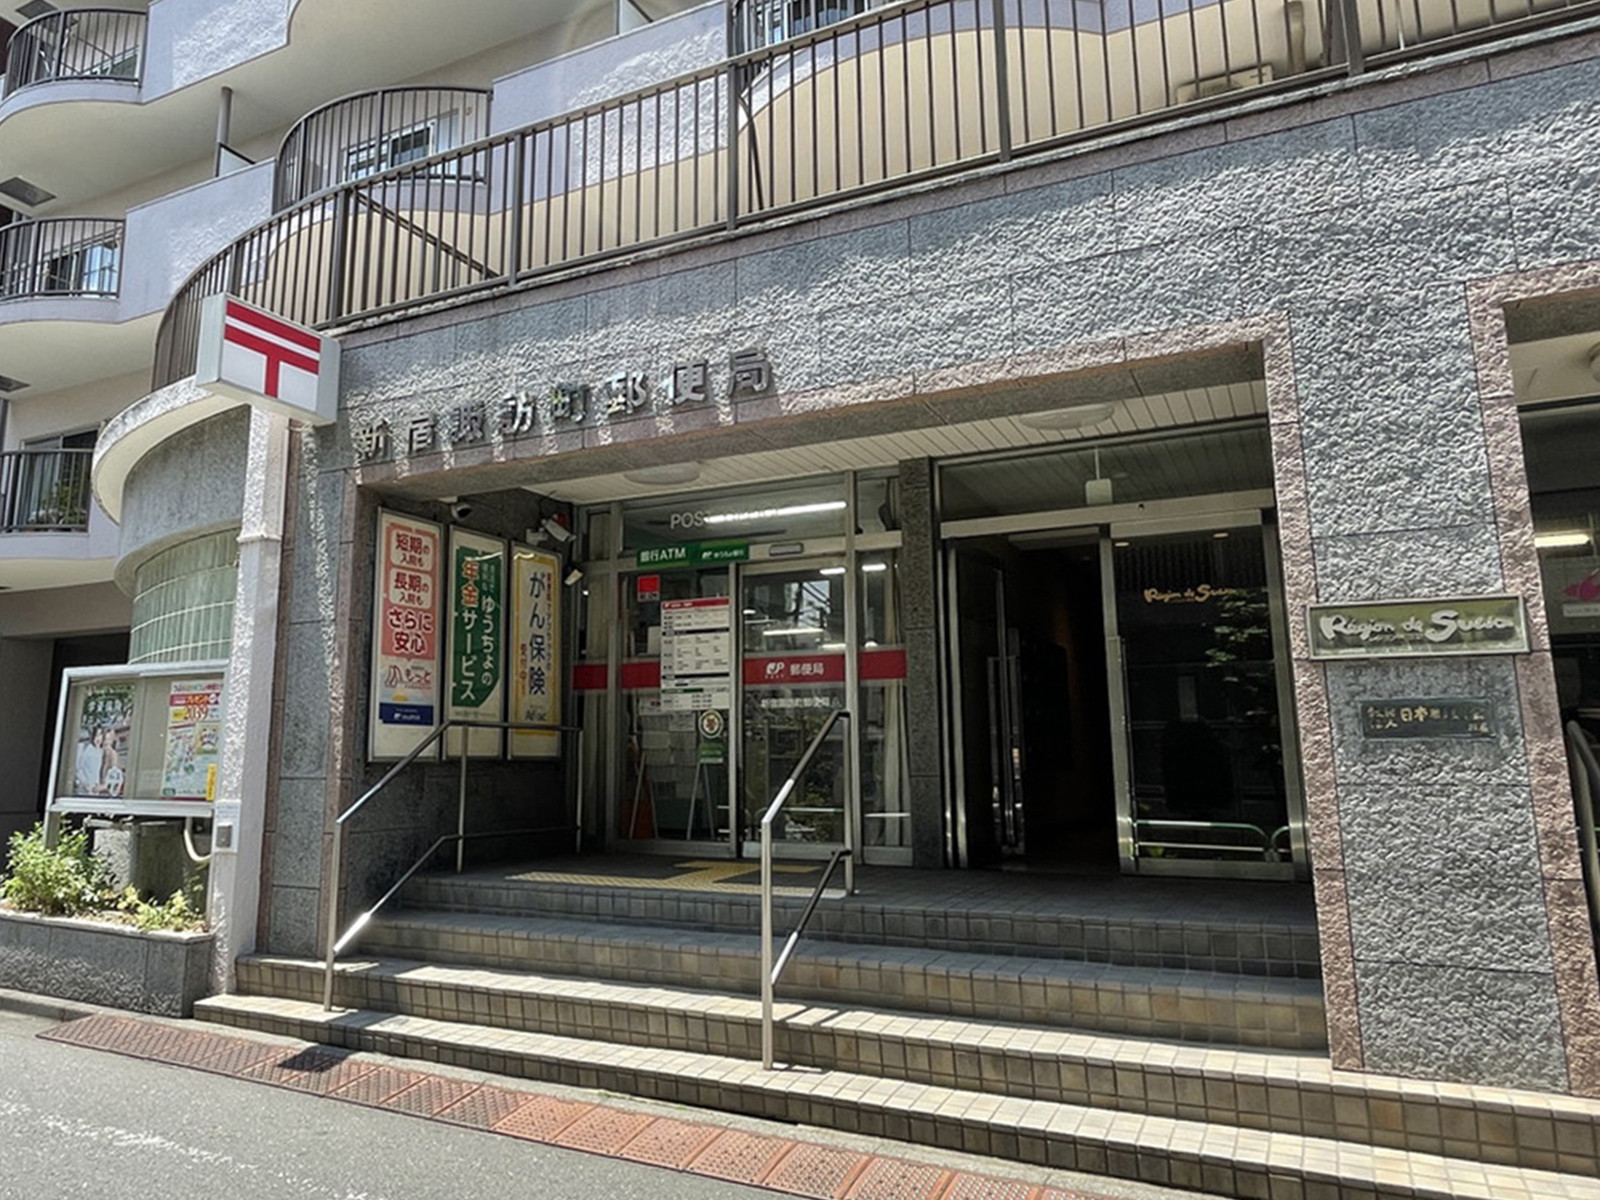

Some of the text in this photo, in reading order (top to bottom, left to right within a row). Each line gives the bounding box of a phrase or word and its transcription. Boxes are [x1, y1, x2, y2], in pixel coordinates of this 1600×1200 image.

[670, 511, 710, 529] POS
[395, 531, 430, 555] 短期の
[640, 547, 687, 563] 銀行ATM
[394, 571, 430, 594] 長期の
[389, 608, 434, 632] さらに
[460, 559, 479, 701] 年金サービス
[1401, 616, 1423, 632] de
[394, 632, 426, 654] 安心
[481, 596, 496, 686] ゆうちょの
[529, 571, 546, 696] がん保険
[789, 661, 825, 676] 郵便局
